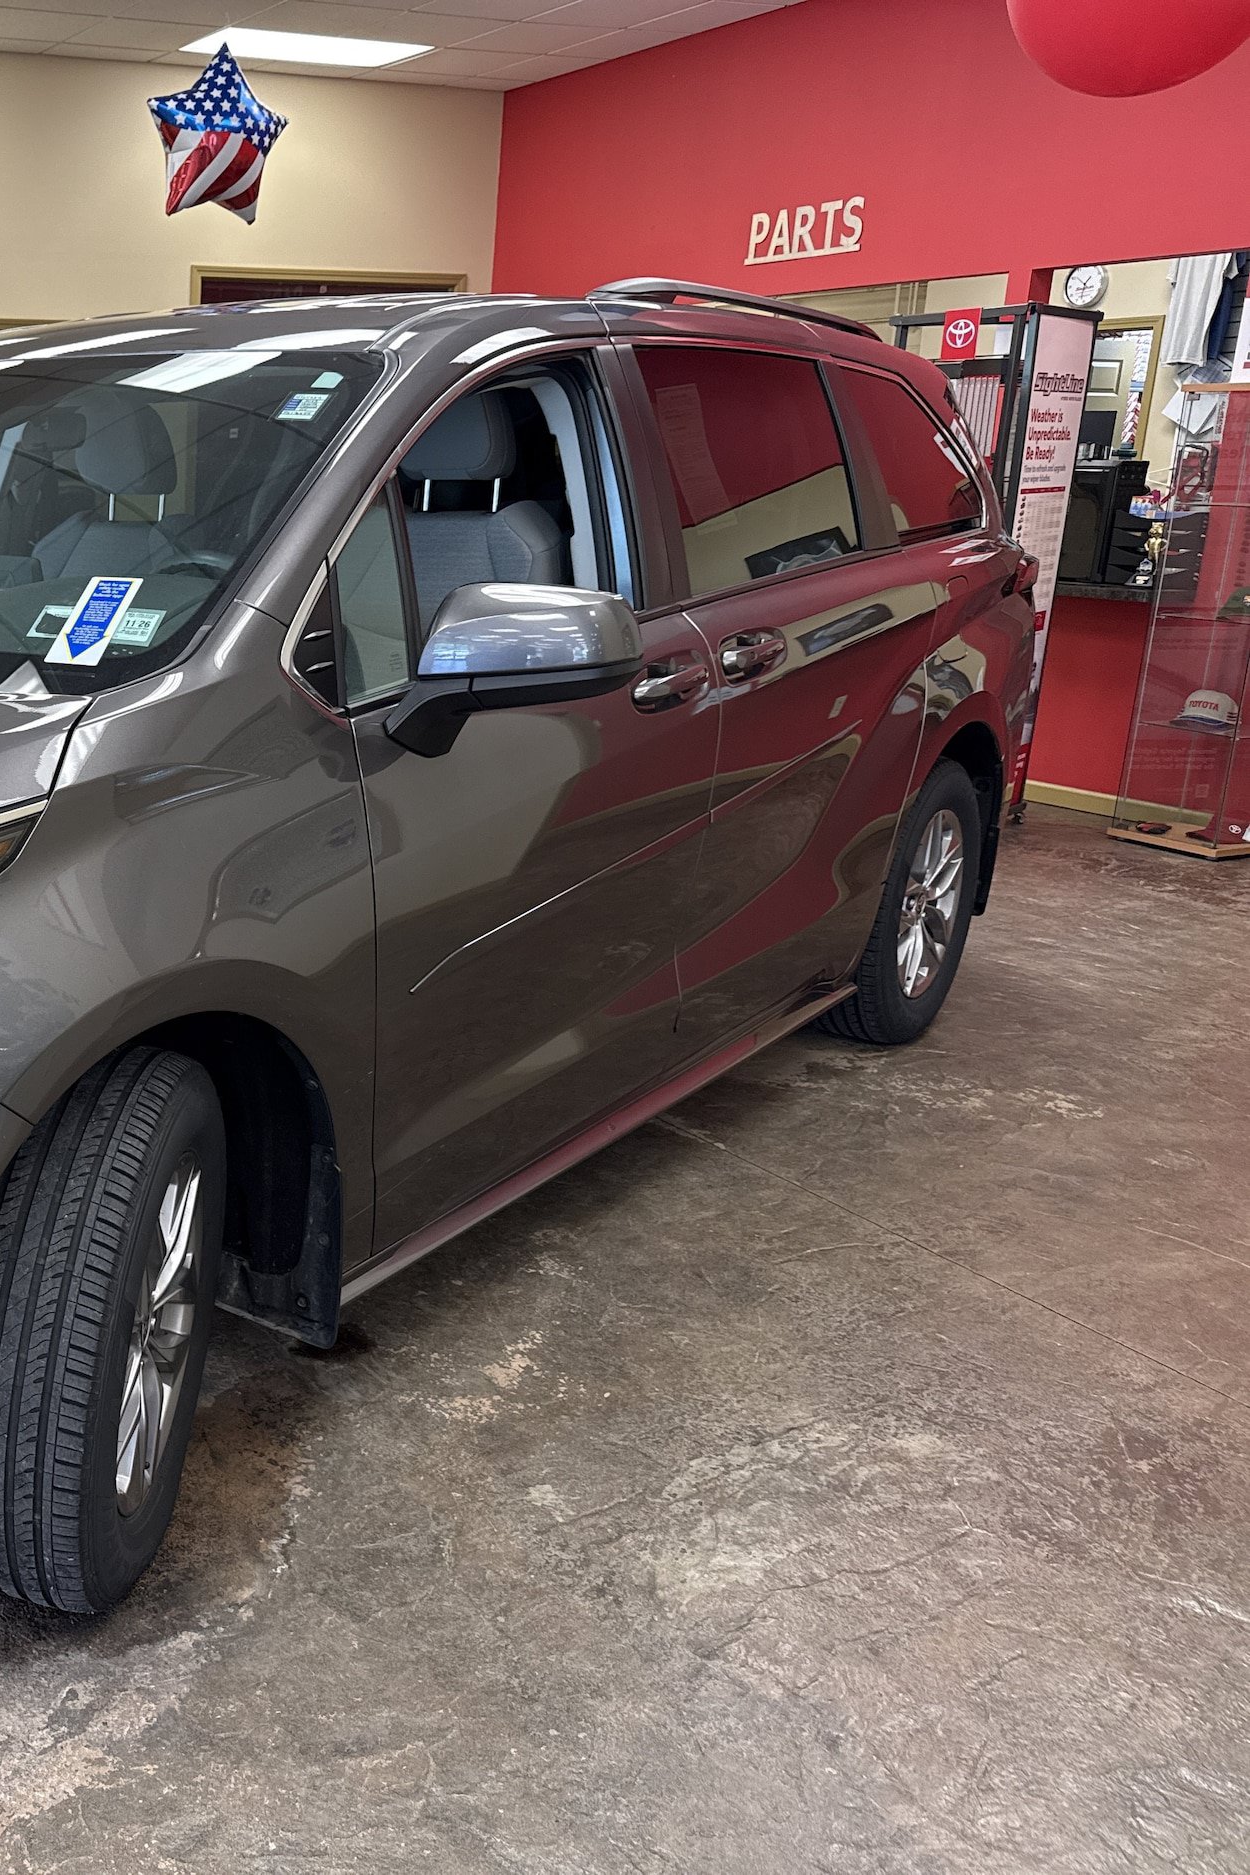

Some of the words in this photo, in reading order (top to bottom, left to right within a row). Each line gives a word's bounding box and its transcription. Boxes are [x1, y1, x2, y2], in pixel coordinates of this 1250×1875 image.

[746, 196, 865, 262] PARTS
[1033, 372, 1085, 397] SightLine
[1030, 408, 1058, 423] Weather
[1058, 408, 1063, 423] is
[1028, 426, 1071, 444] Unpredictable.
[1025, 446, 1034, 460] Be
[1035, 446, 1056, 463] Ready!
[125, 619, 136, 627] 11
[138, 620, 151, 628] 26
[1189, 700, 1219, 711] TOYOTA
